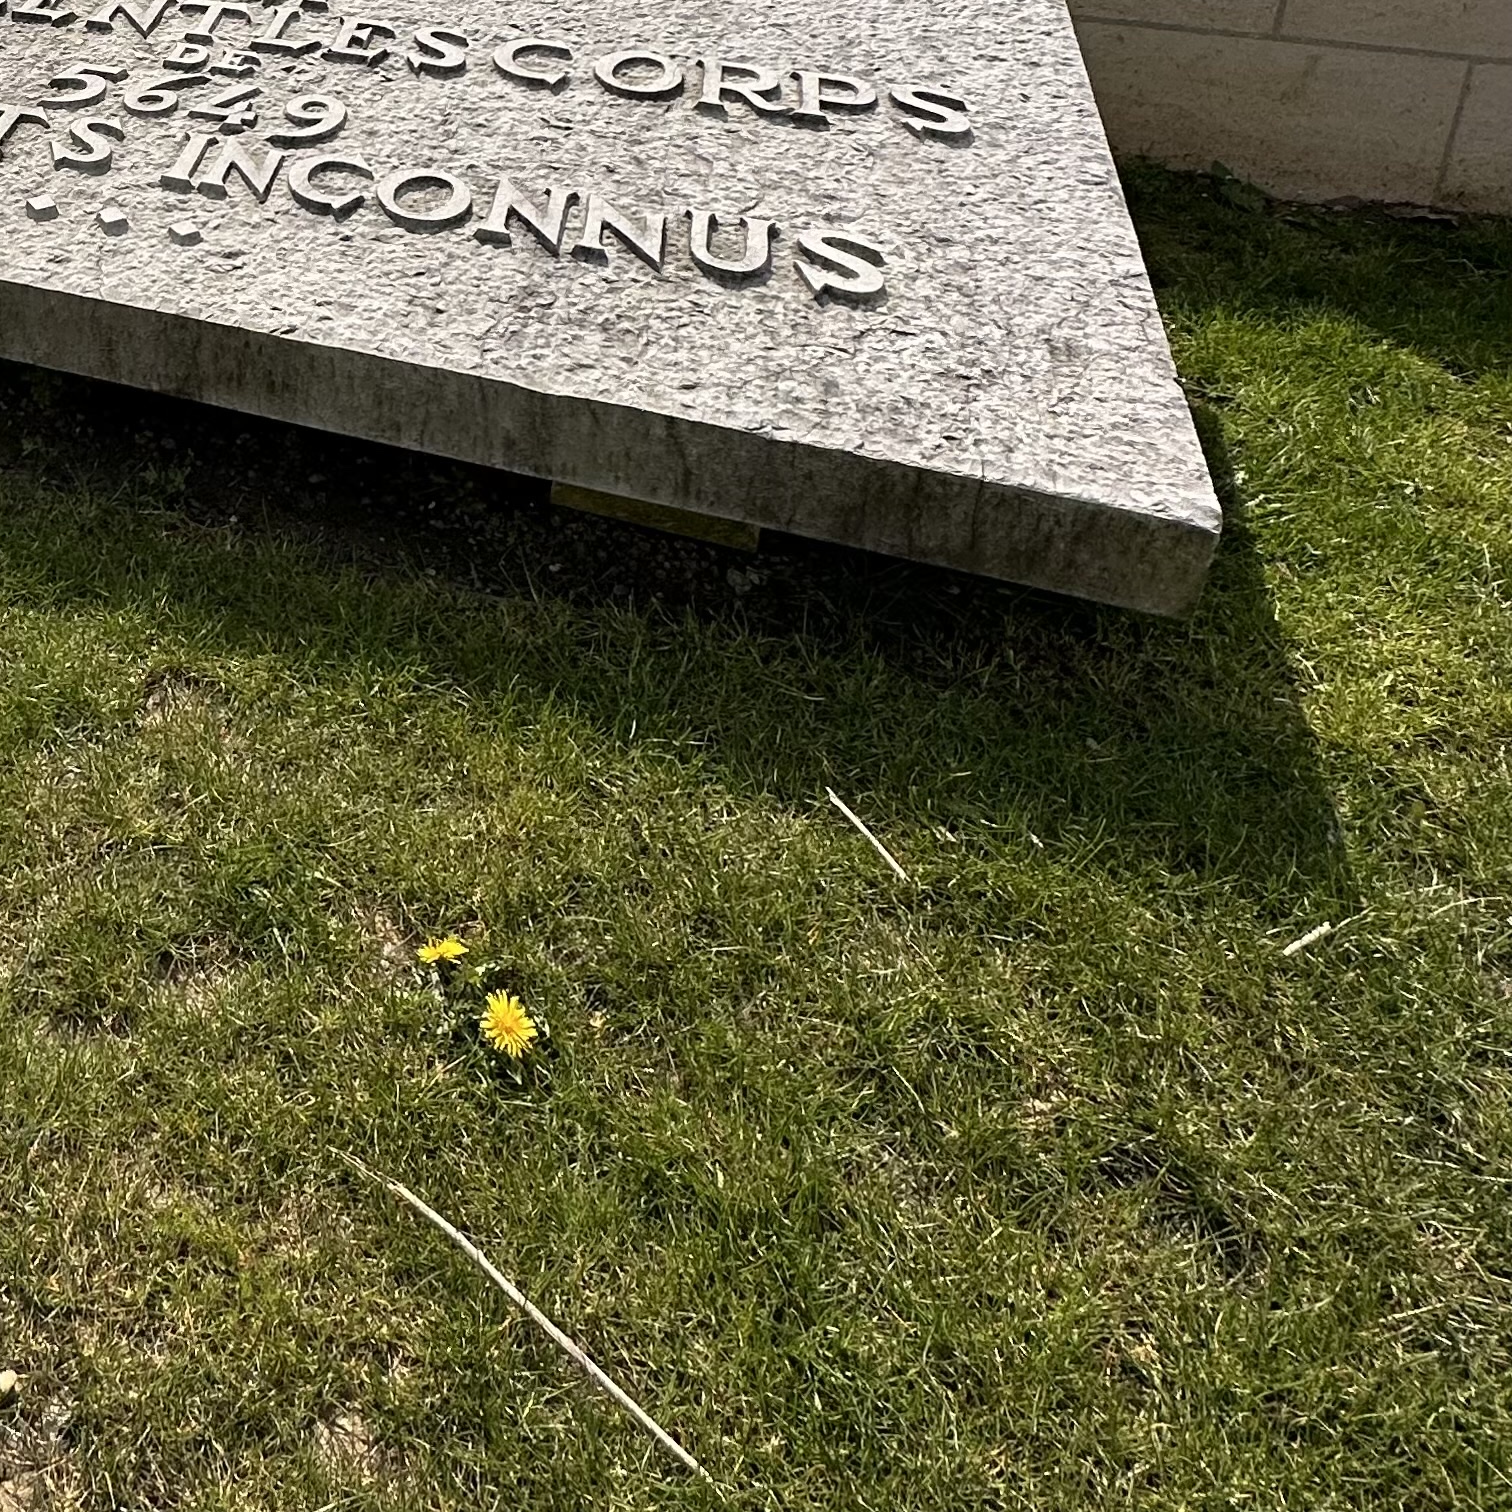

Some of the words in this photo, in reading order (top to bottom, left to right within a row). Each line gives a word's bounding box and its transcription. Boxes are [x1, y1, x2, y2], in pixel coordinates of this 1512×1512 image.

[39, 64, 348, 147] 5649
[162, 42, 261, 78] DE
[249, 8, 470, 78] LES
[492, 38, 976, 143] CORPS
[160, 132, 889, 302] INCONNUS
